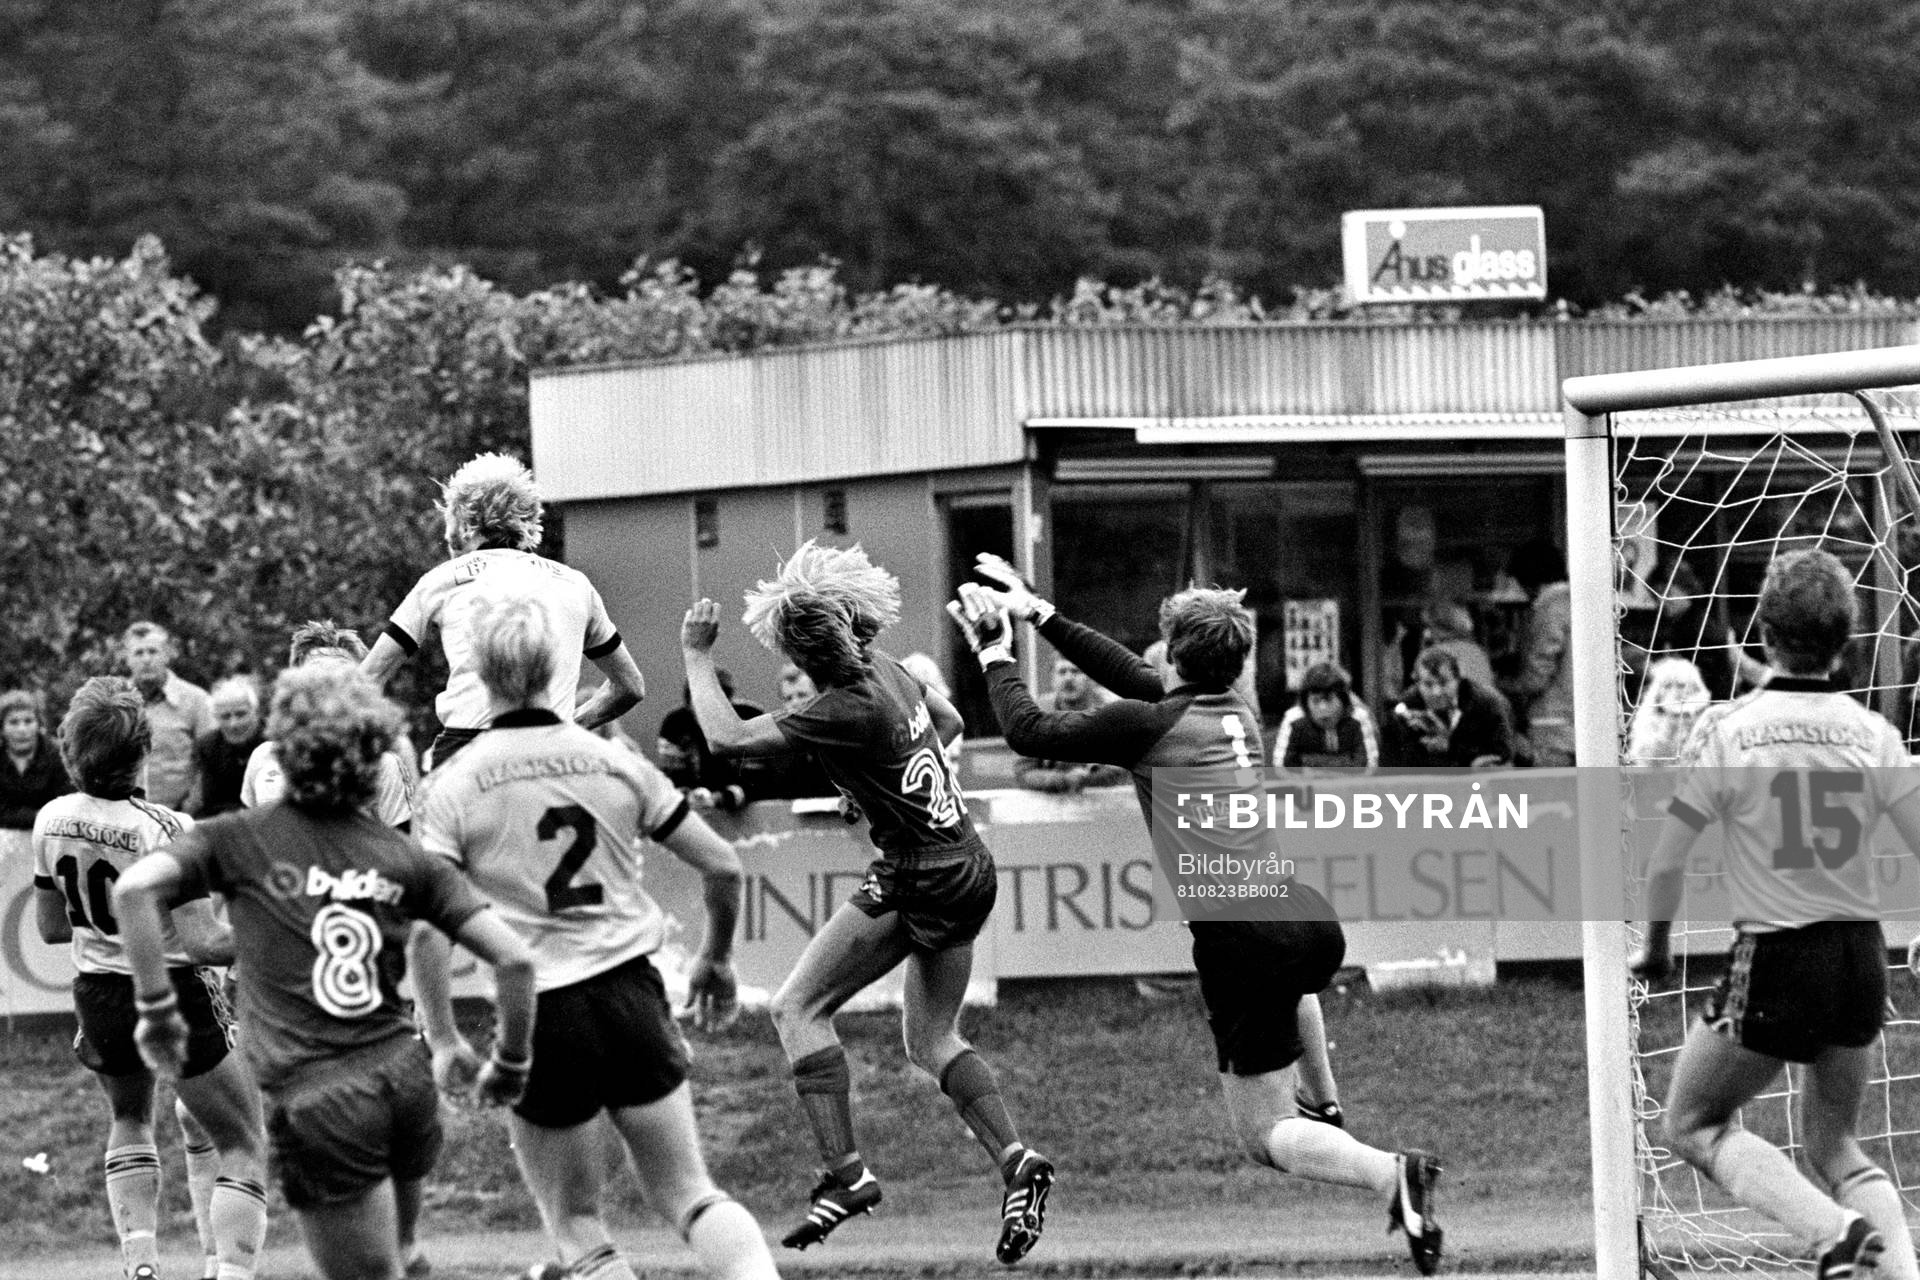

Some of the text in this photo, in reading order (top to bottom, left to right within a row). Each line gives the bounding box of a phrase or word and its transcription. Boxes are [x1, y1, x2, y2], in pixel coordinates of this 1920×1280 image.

[1452, 234, 1537, 287] glass
[45, 818, 141, 853] BLACKSTONE
[536, 804, 604, 913] 2
[1770, 770, 1864, 870] 15
[310, 902, 383, 1019] 8
